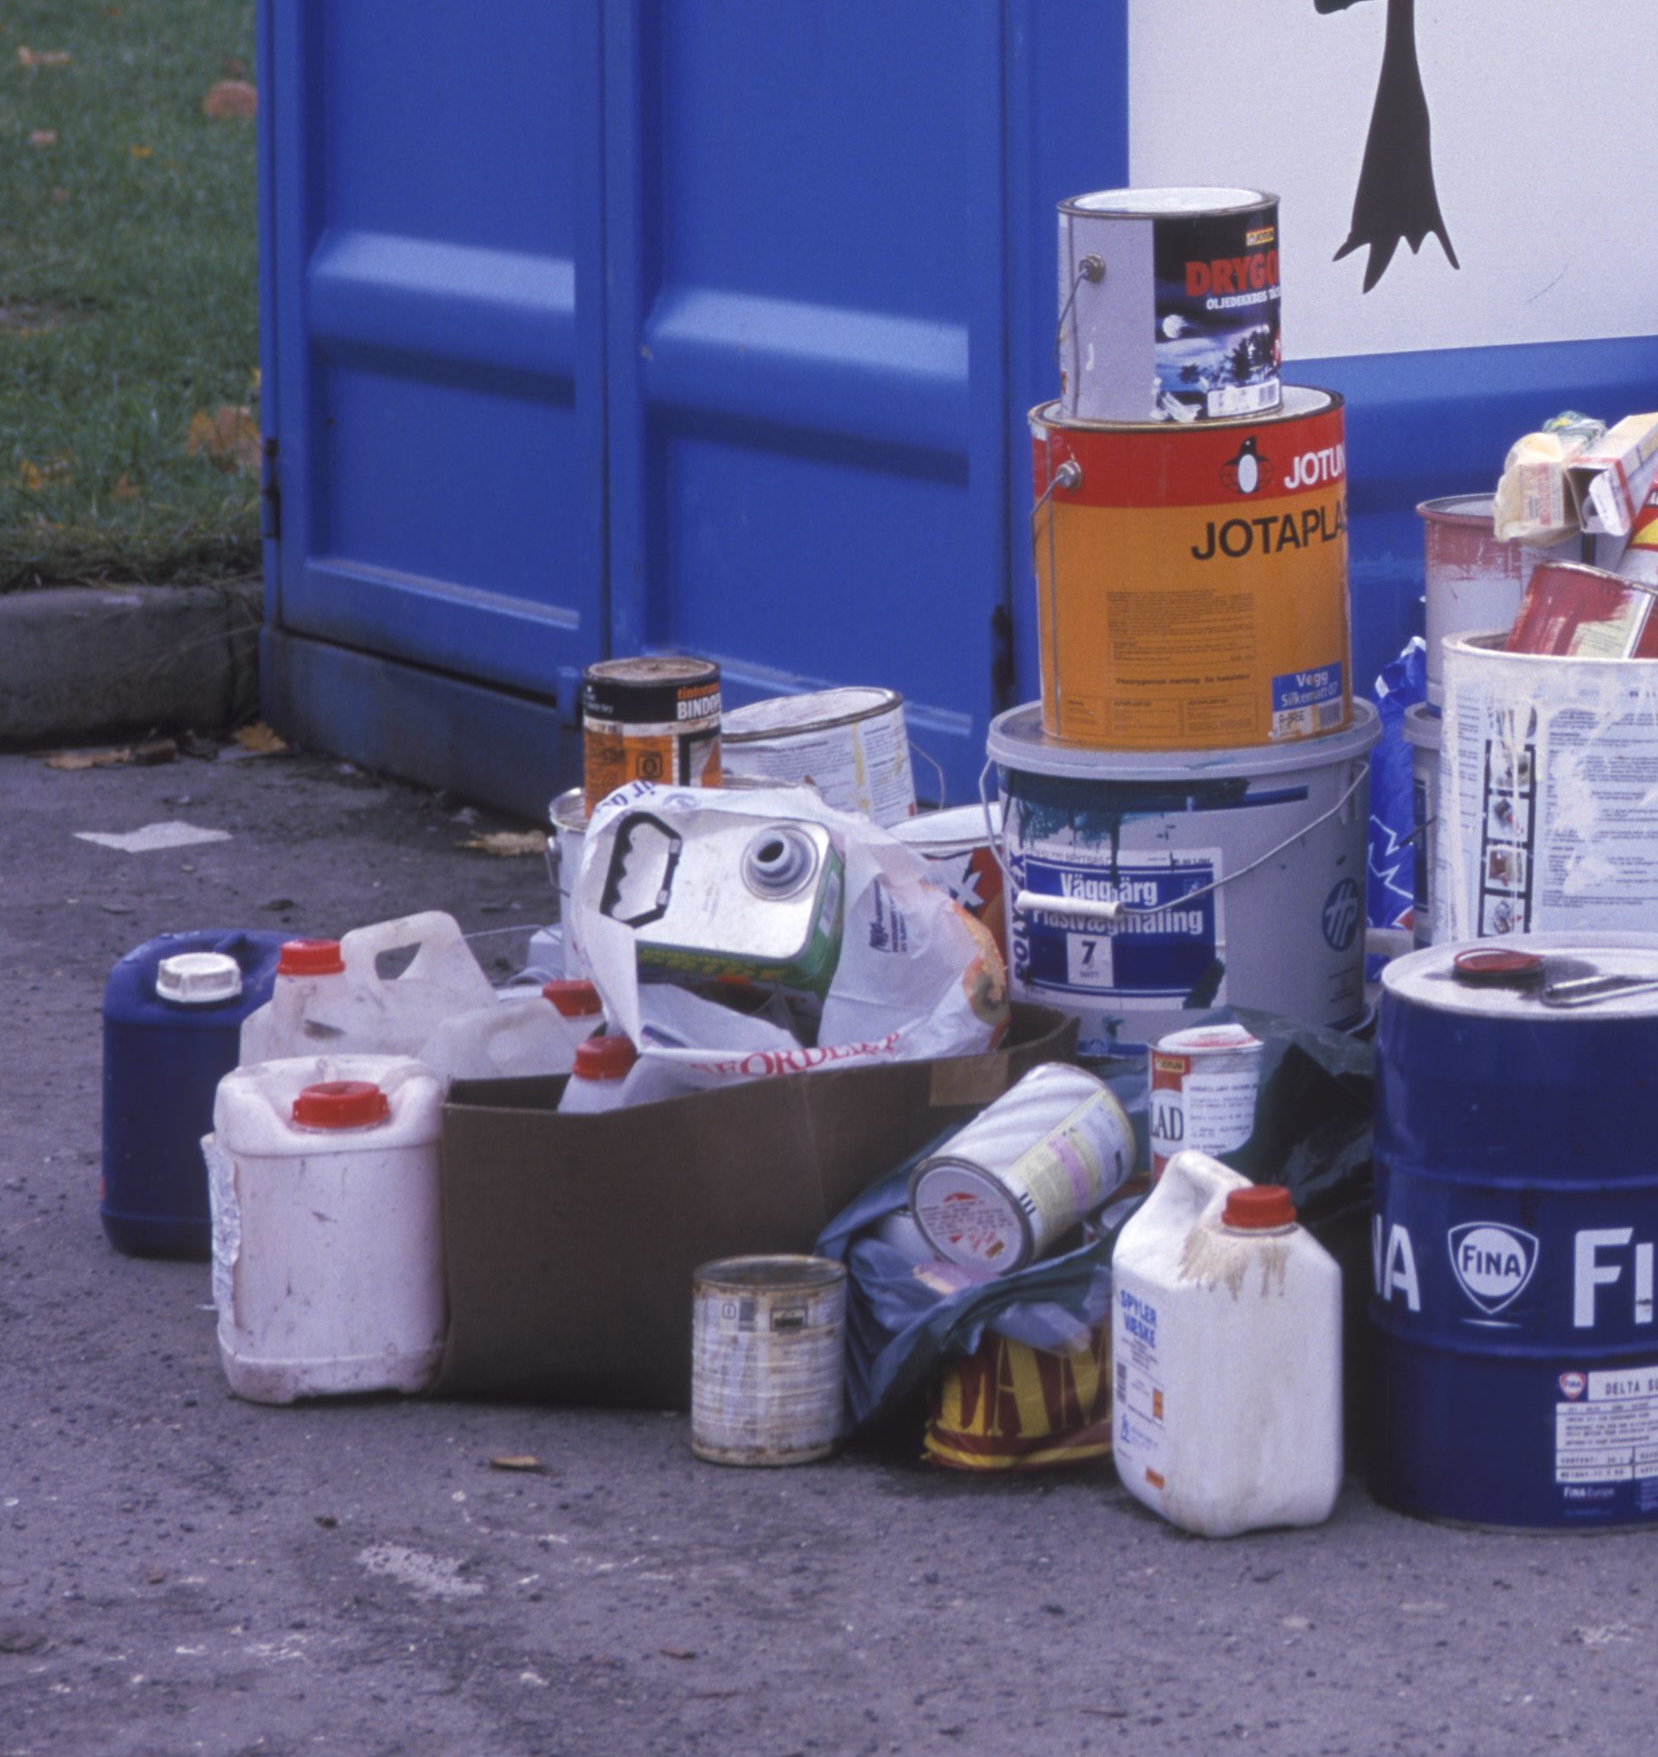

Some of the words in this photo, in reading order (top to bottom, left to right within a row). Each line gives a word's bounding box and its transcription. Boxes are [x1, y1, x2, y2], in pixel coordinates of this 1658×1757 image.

[1295, 670, 1329, 688] Vegg
[1081, 940, 1097, 965] 7
[1461, 1243, 1523, 1279] FINA
[1605, 1381, 1641, 1396] DELTA
